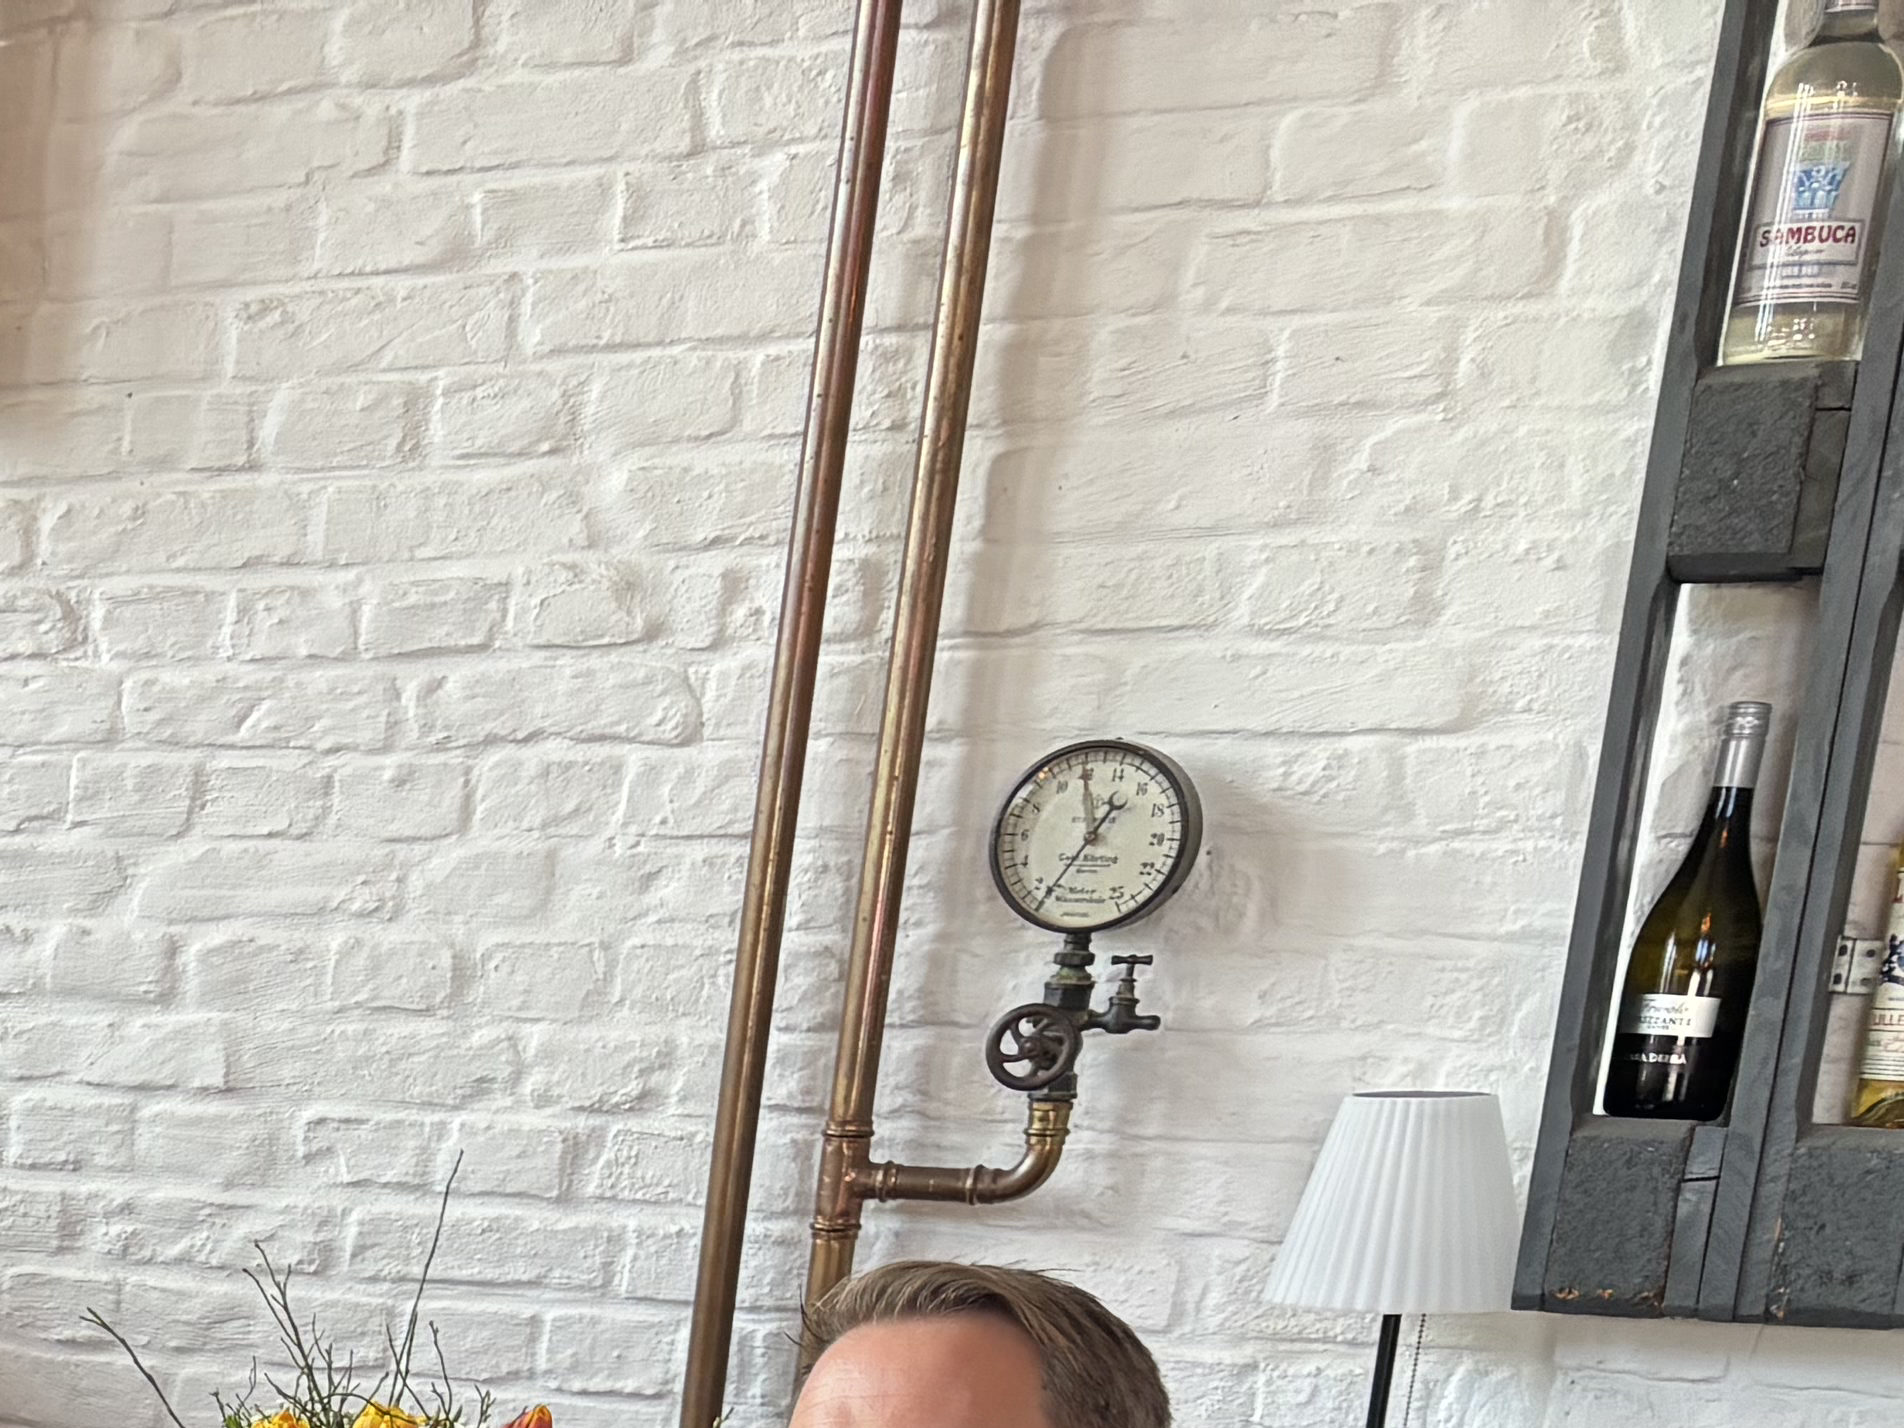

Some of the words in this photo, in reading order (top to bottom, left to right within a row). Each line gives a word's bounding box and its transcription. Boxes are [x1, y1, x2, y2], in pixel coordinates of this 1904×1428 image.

[1759, 224, 1857, 248] SAMBUCA
[1111, 768, 1125, 782] 14
[1135, 782, 1148, 796] 16
[1151, 803, 1165, 818] 18
[1149, 833, 1165, 847] 20
[1139, 862, 1155, 876] 22
[1109, 886, 1125, 900] 25
